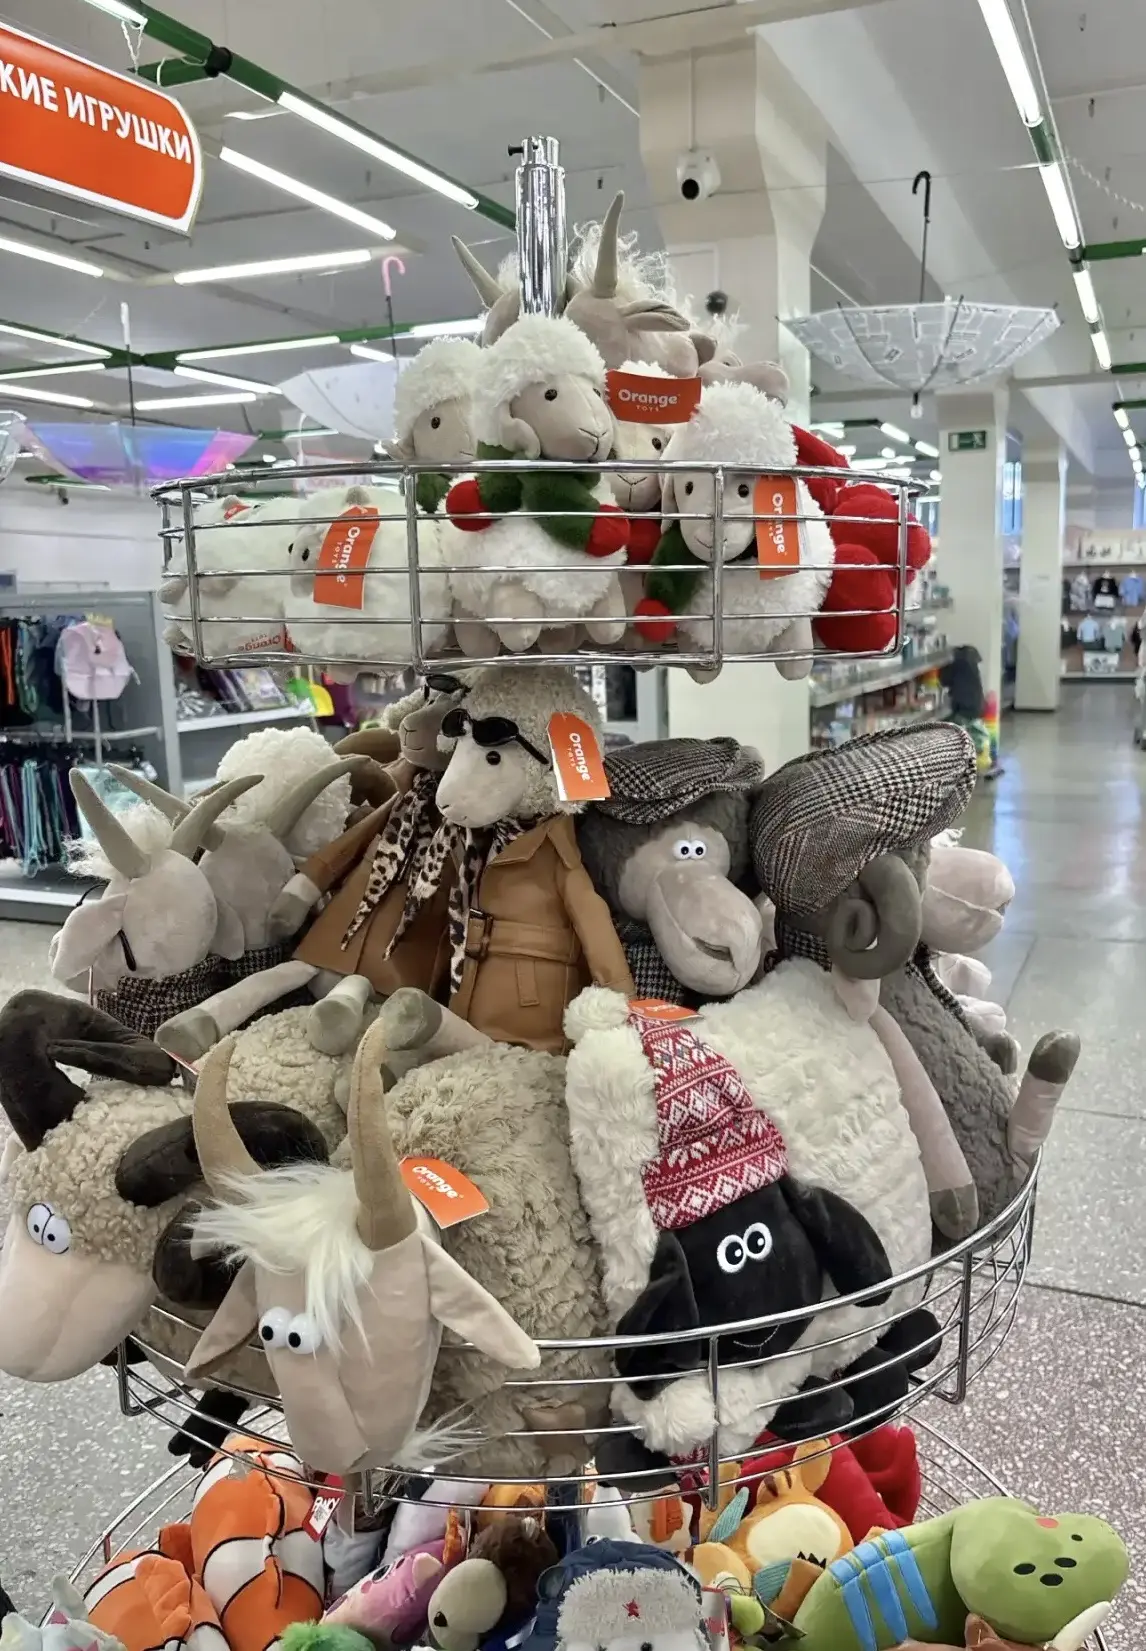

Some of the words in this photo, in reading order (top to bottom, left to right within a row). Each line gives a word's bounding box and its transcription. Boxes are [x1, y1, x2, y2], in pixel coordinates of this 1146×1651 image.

[64, 86, 192, 164] ИГРУШКИ
[618, 388, 678, 408] Orange
[772, 493, 785, 553] Ornge
[569, 732, 591, 781] Orange
[412, 1166, 458, 1198] Orange
